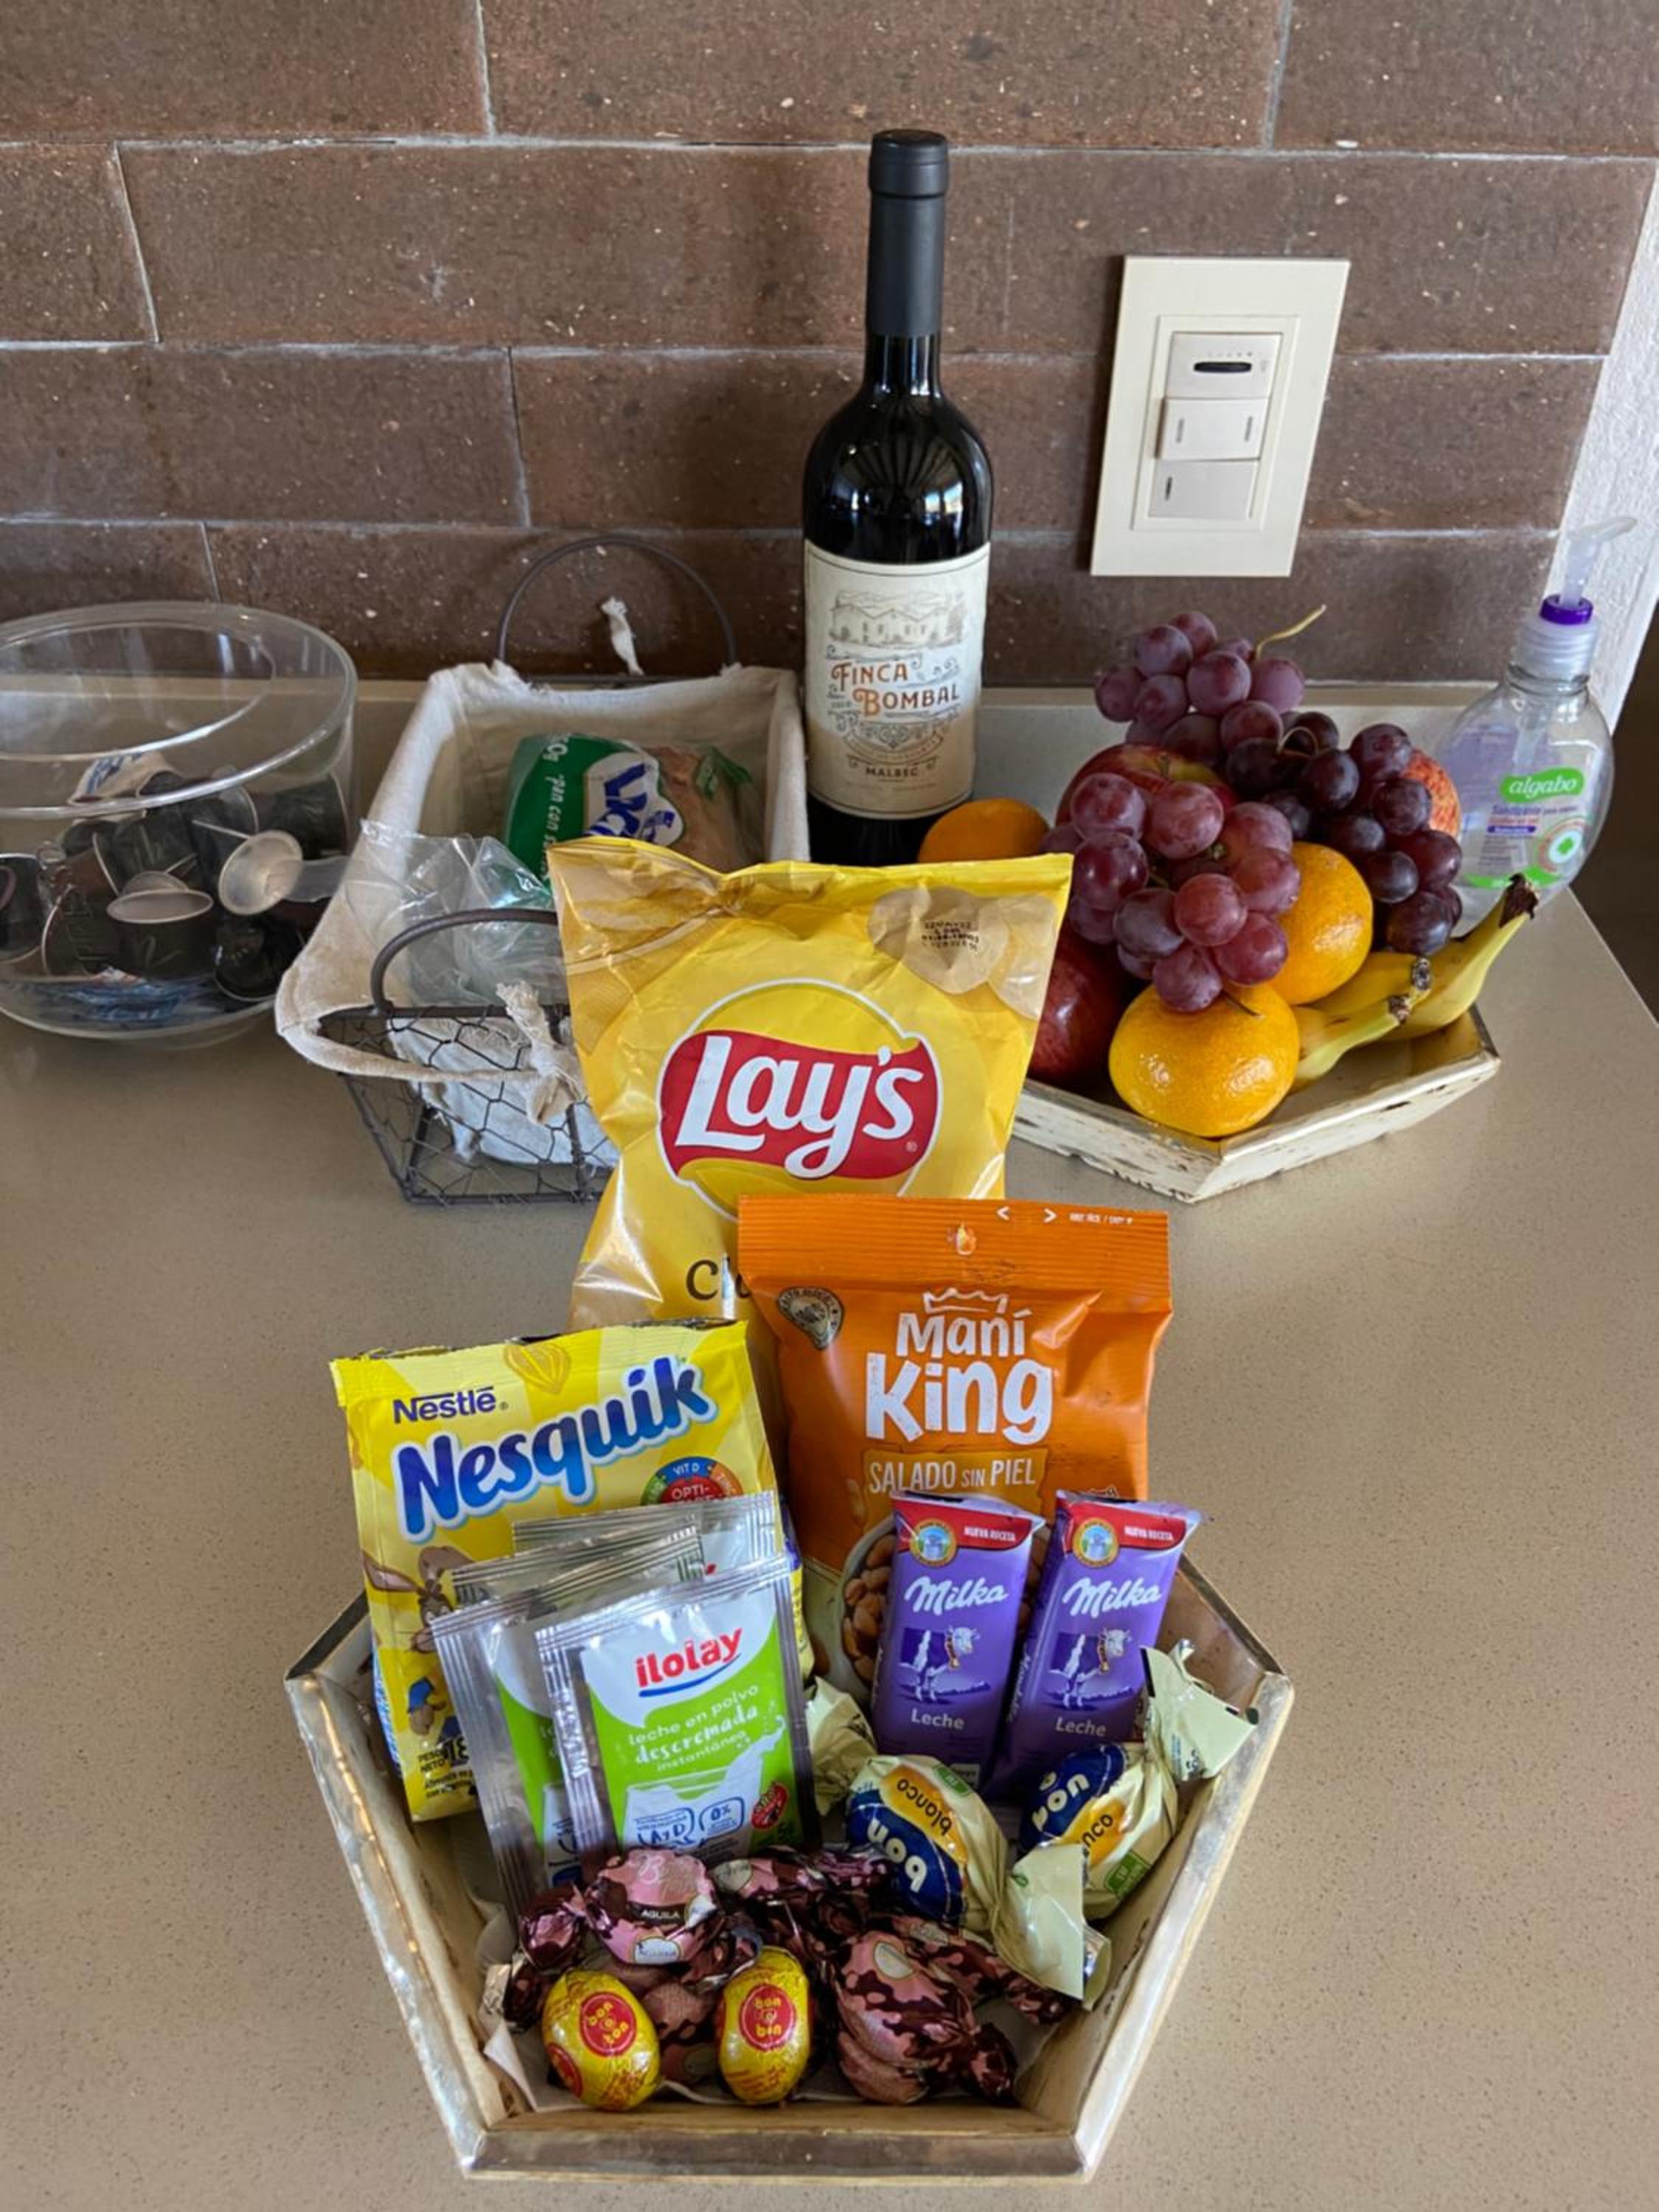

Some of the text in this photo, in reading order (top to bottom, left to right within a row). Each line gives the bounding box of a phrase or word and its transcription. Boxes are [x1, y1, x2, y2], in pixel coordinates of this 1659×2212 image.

[831, 662, 908, 692] FINCA
[852, 684, 960, 717] BOMBAL
[866, 766, 919, 778] MALBEC
[1509, 776, 1577, 799] algabo
[674, 1035, 924, 1179] Lay's
[896, 1309, 1032, 1358] Maní
[393, 1385, 496, 1424] Nestlé
[866, 1352, 1053, 1444] King
[395, 1355, 712, 1537] Nesquik
[672, 1462, 700, 1475] VIT D
[869, 1458, 1035, 1493] SALADO SIN PIEL
[905, 1576, 1009, 1615] Milka
[1062, 1577, 1163, 1617] Milka
[636, 1628, 742, 1687] ilolay
[712, 1684, 758, 1717] polvo
[636, 1705, 757, 1764] descremada
[911, 1708, 964, 1731] Leche
[1055, 1717, 1106, 1737] Leche
[897, 1778, 953, 1836] blanco
[1081, 1814, 1113, 1848] nco
[867, 1818, 928, 1893] bon
[590, 2000, 613, 2027] bon
[754, 1997, 782, 2010] bon
